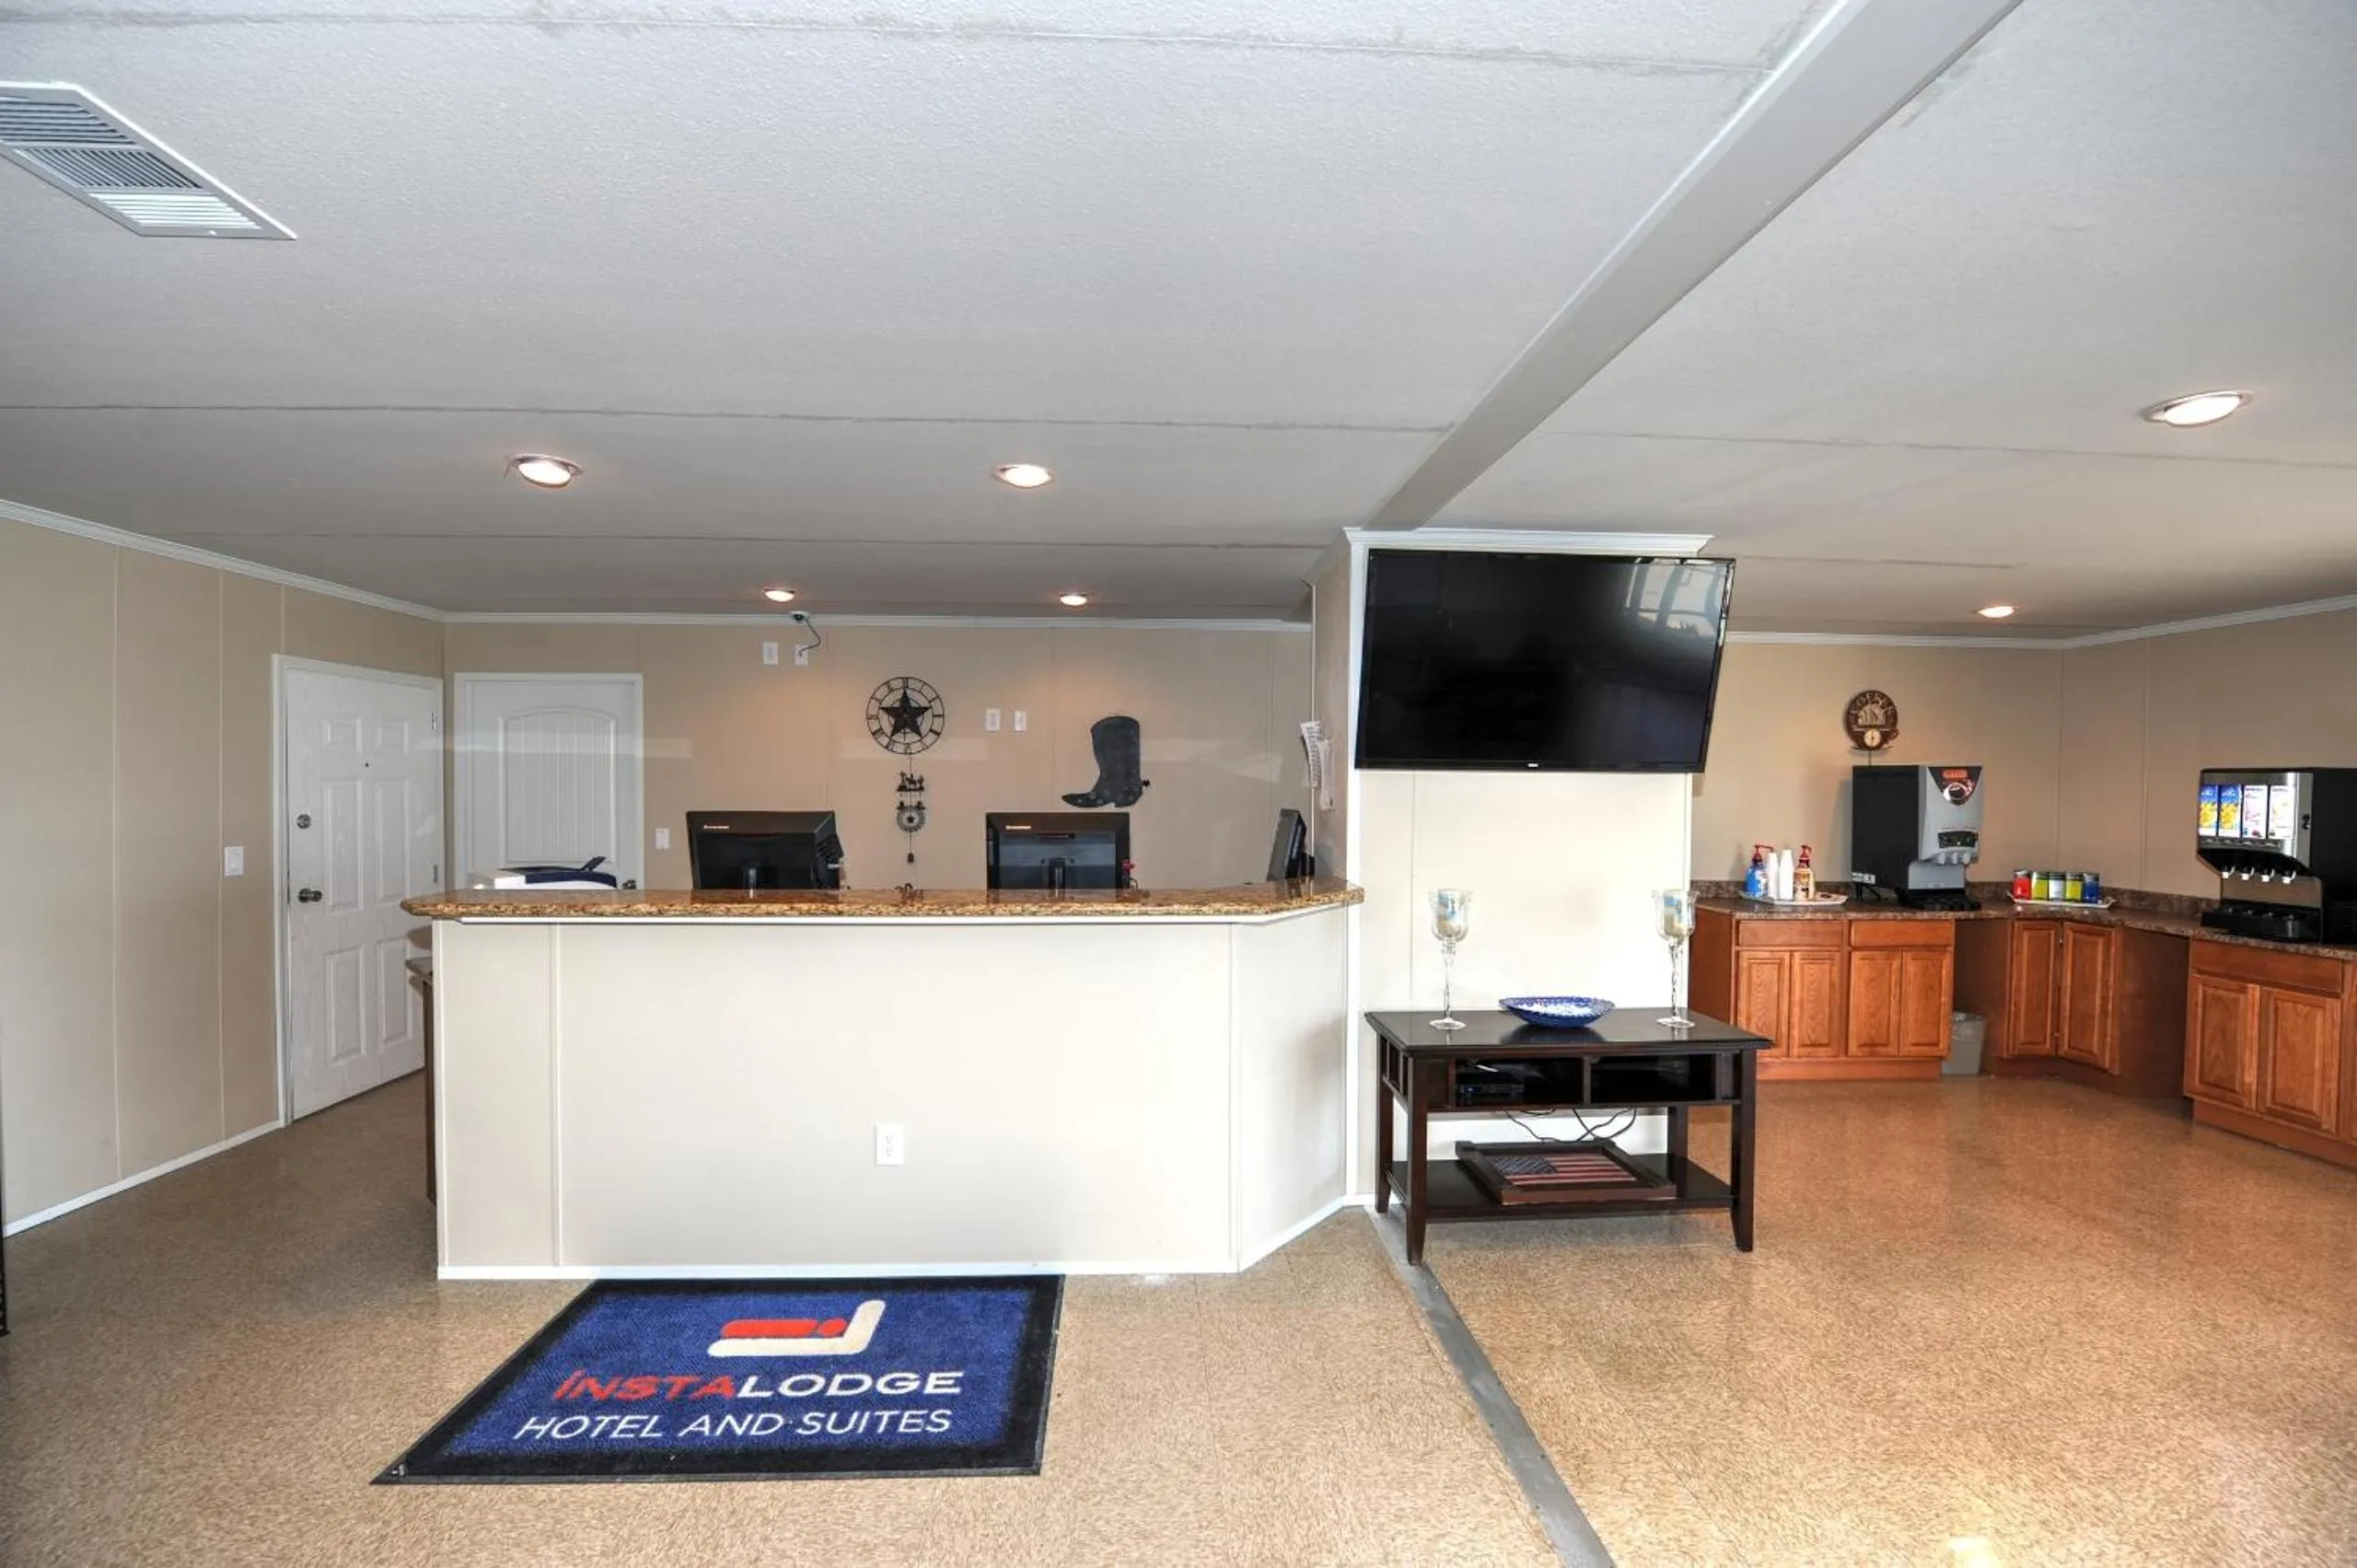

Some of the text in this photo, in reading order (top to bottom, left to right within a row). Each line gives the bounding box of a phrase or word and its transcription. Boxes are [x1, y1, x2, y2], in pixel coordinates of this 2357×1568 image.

[514, 1410, 952, 1439] HOTEL AND SUITES
